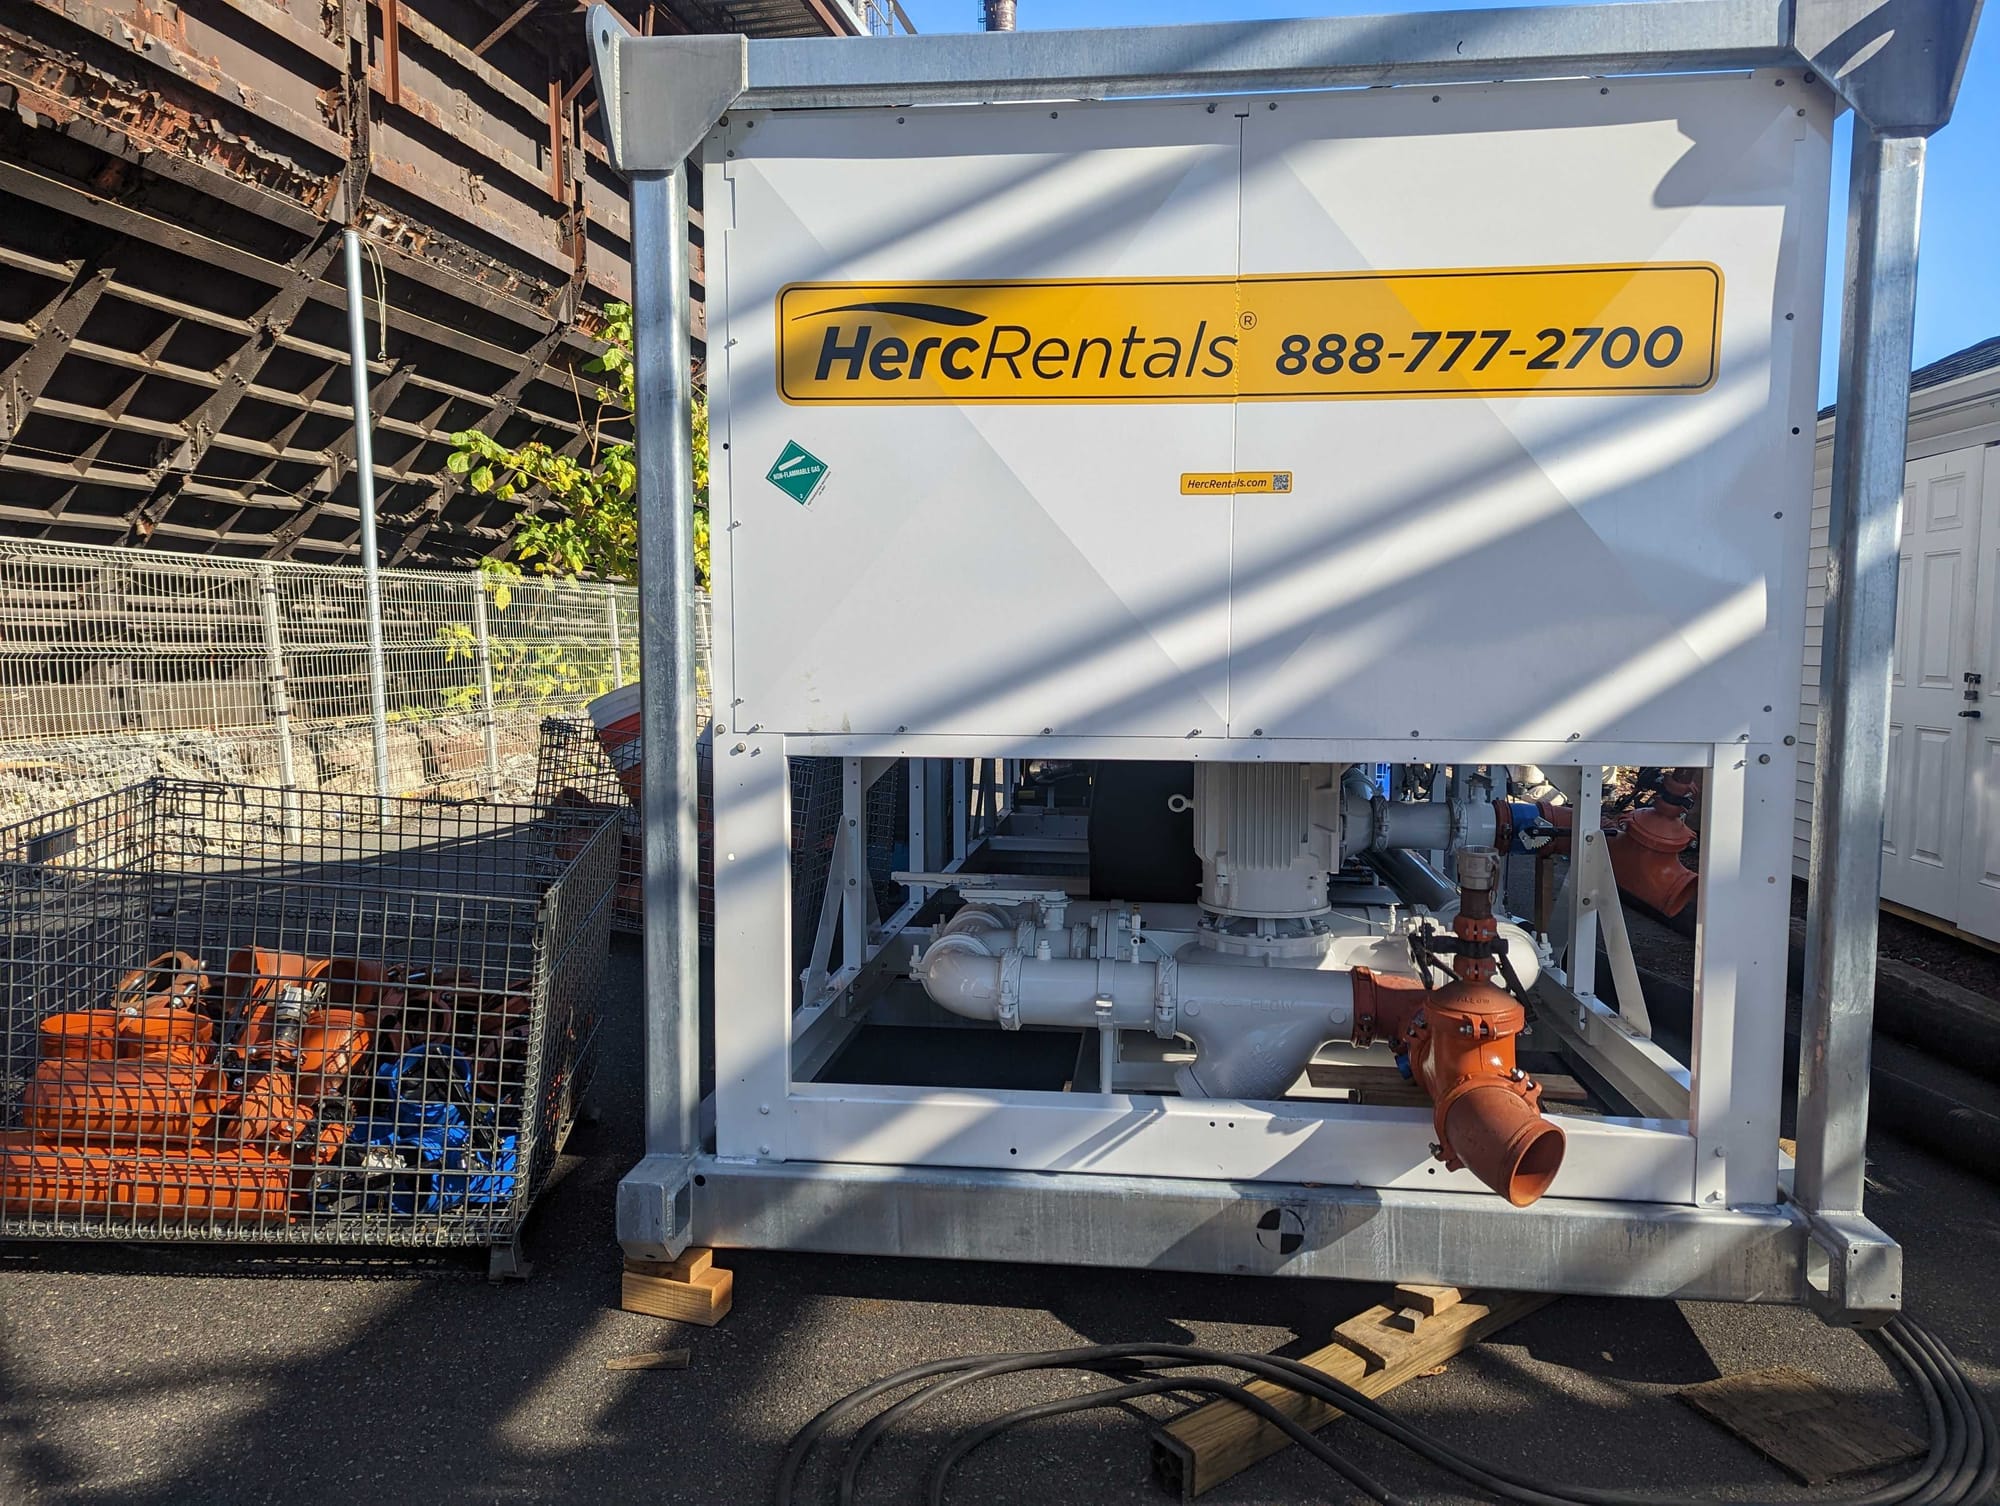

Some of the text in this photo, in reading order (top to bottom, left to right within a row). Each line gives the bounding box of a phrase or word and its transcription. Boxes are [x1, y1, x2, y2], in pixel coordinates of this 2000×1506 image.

[1275, 325, 1684, 375] 888-777-2700
[773, 465, 821, 480] NON-FLAMMABLE GAS
[1188, 479, 1267, 489] HercRentals.com
